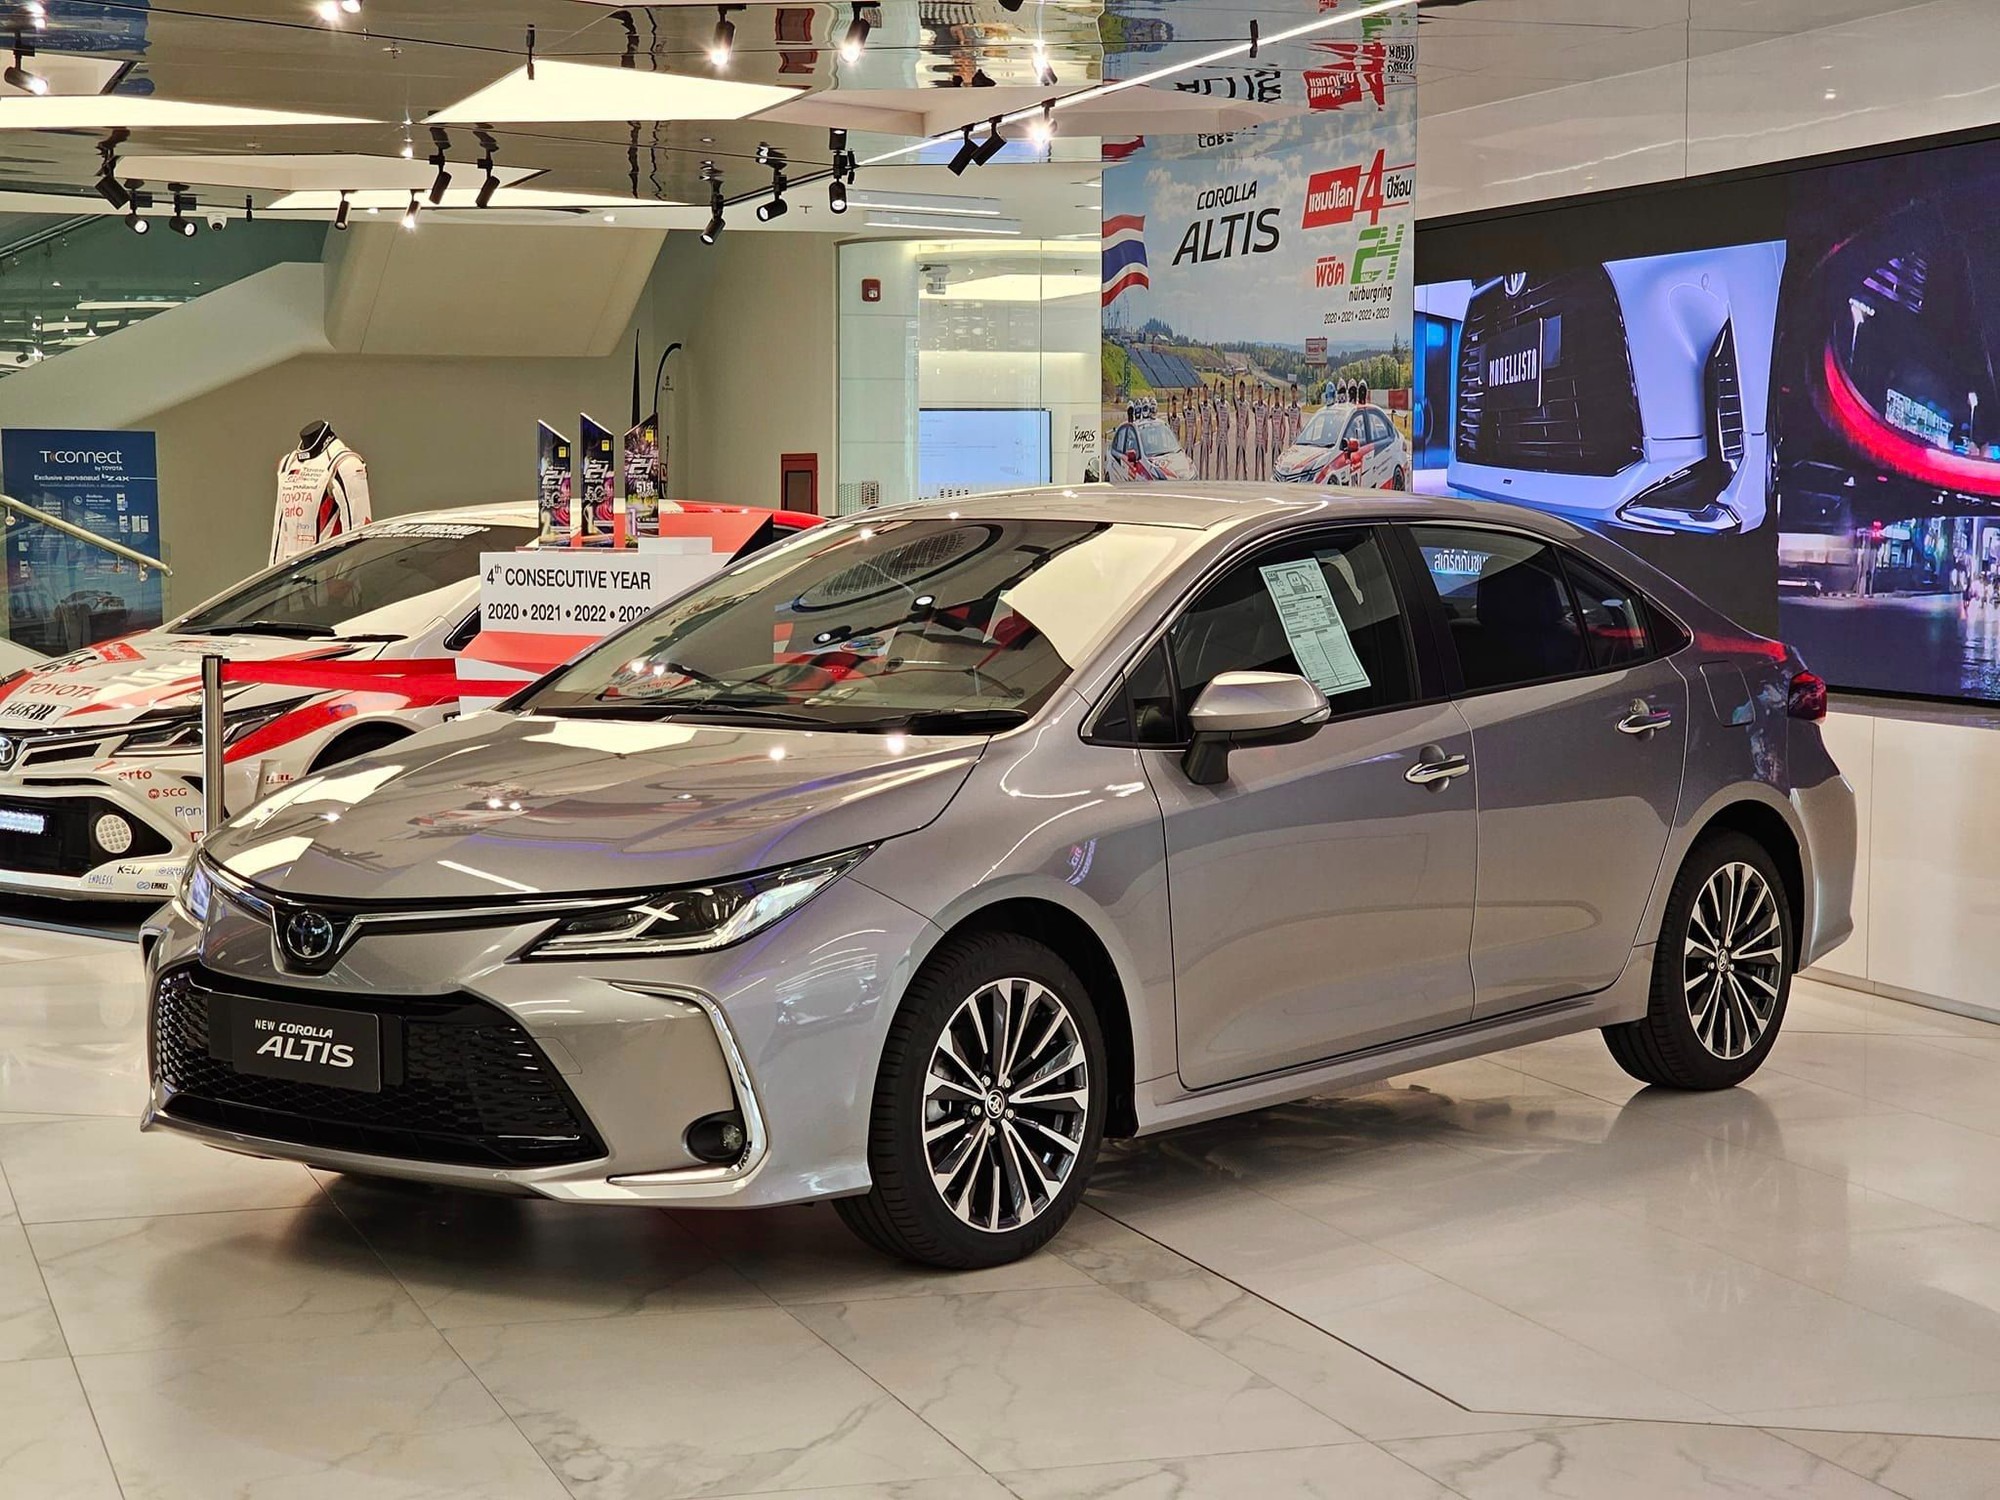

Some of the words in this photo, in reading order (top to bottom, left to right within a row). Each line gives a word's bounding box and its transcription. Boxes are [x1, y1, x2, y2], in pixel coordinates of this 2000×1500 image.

[1197, 180, 1258, 211] COROLLA
[1360, 149, 1385, 226] 4
[1387, 175, 1413, 200] ปีซ้อน
[1171, 207, 1281, 267] ALTIS
[1349, 284, 1393, 303] nürburgring
[1324, 312, 1338, 325] 2020
[1341, 311, 1355, 323] 2021
[1358, 309, 1372, 321] 2022
[1375, 307, 1390, 320] 2023
[1488, 348, 1538, 388] MODELLISTA
[282, 492, 313, 503] TOYOTA
[1434, 549, 1488, 572] สเกิร์ตกันช
[487, 564, 502, 585] 4th
[505, 568, 607, 588] CONSECUTIVE
[611, 571, 651, 589] YEAR
[488, 603, 519, 620] 2020
[531, 604, 561, 621] 2021
[574, 605, 606, 622] 2022
[618, 606, 651, 622] 202
[163, 788, 187, 797] SCG
[255, 1019, 275, 1031] NEW
[278, 1022, 334, 1039] COROLLA
[256, 1035, 354, 1068] ALTIS
